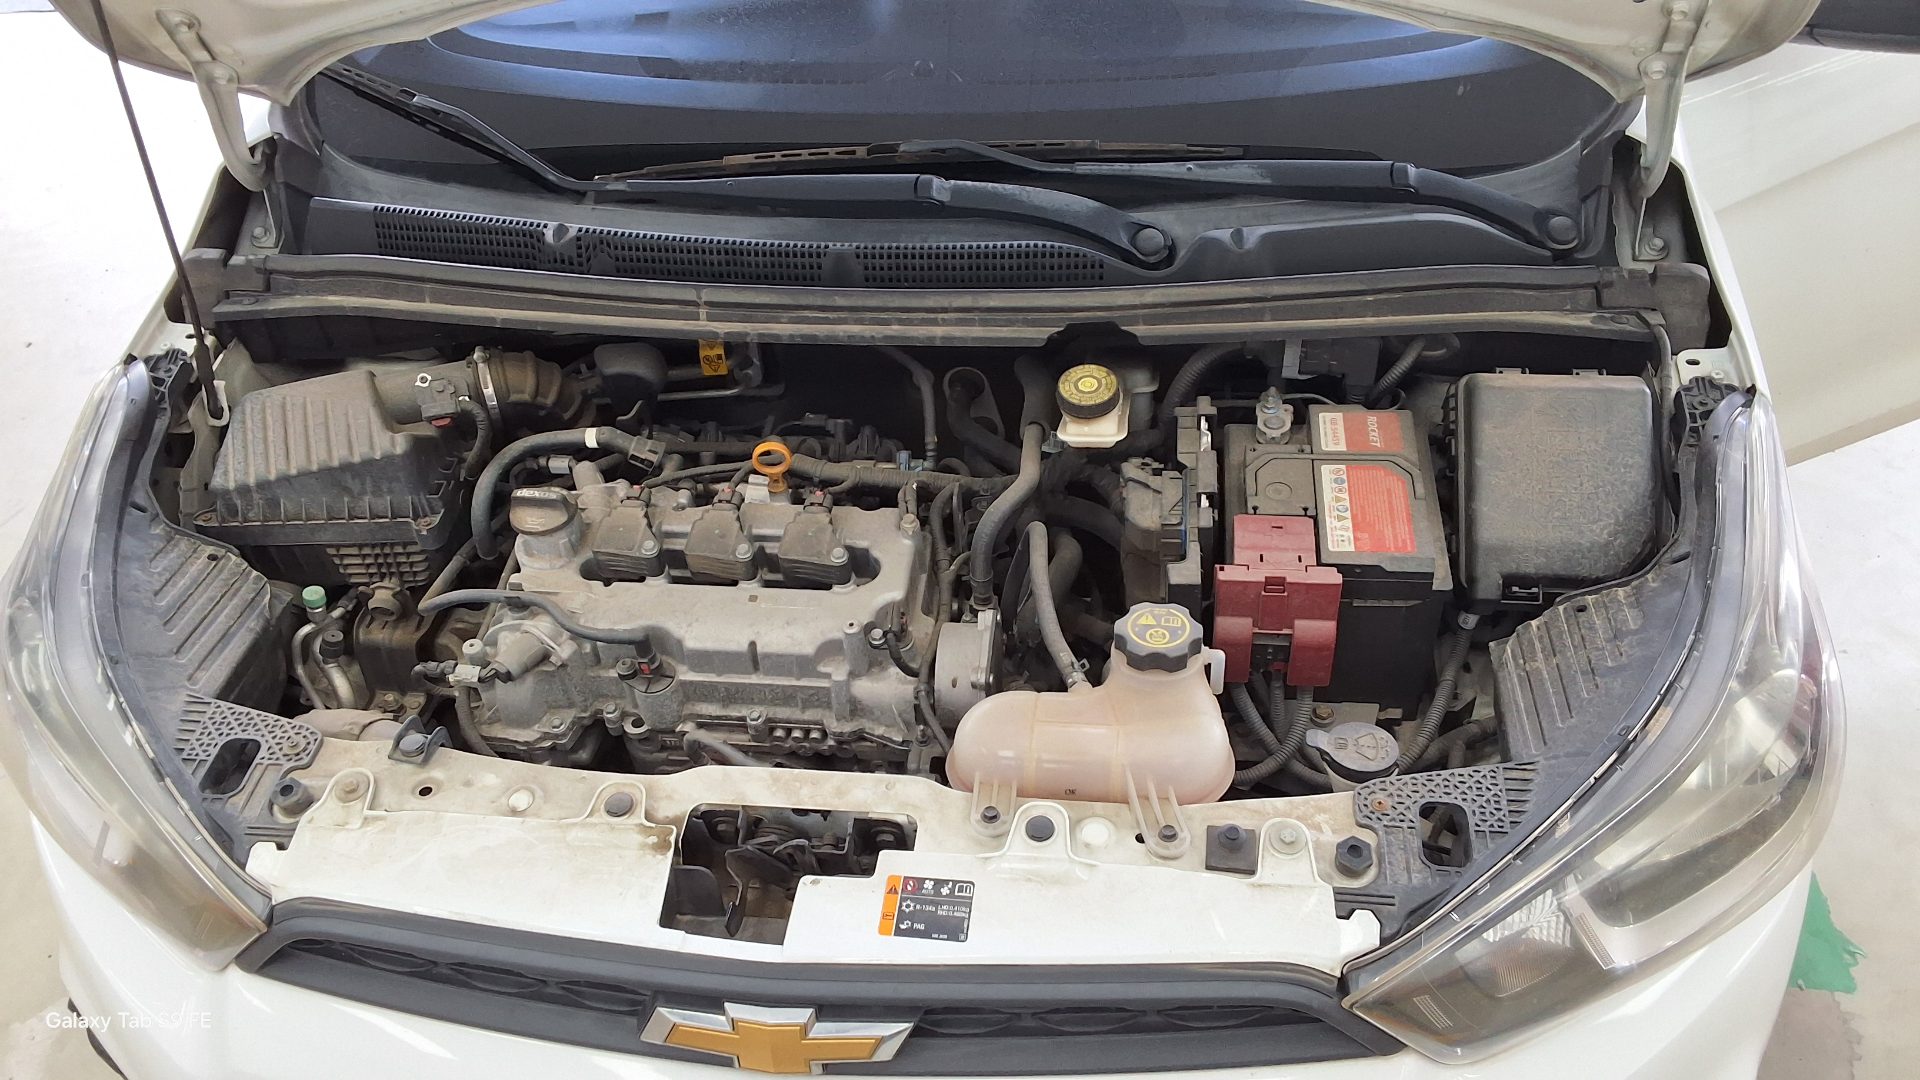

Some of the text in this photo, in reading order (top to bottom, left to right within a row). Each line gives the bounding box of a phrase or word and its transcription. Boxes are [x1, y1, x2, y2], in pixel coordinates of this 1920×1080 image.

[1367, 416, 1381, 448] ROCKET
[516, 488, 557, 499] dexos
[915, 903, 936, 912] R-134a
